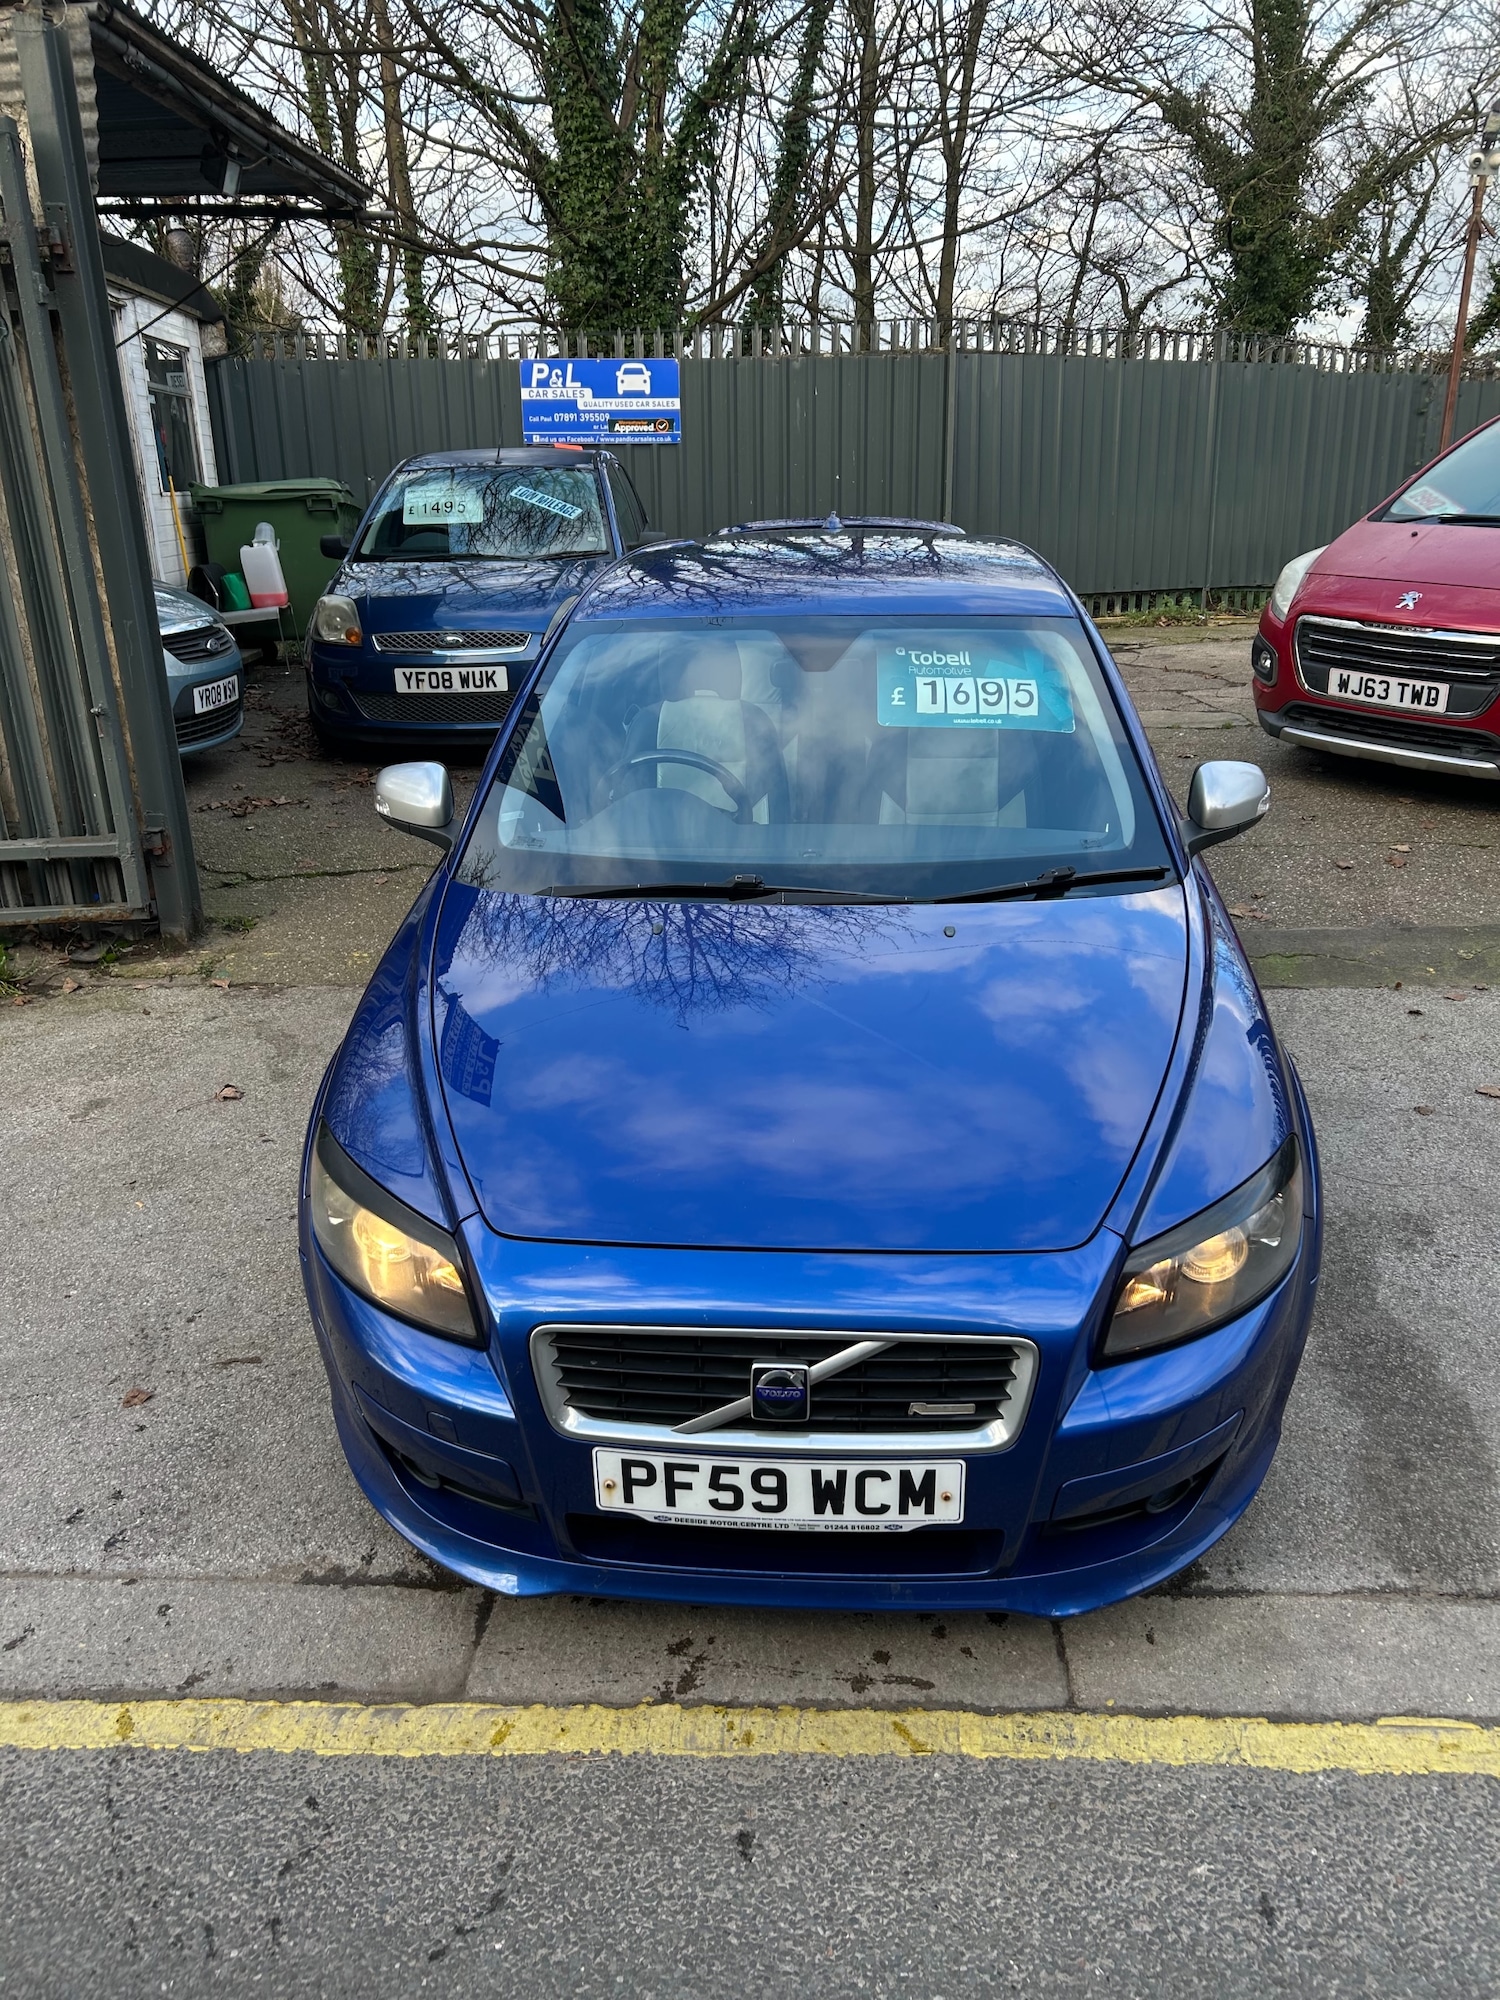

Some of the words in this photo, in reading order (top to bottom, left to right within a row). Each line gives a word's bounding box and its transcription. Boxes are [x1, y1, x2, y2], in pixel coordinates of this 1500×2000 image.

[531, 362, 582, 388] P&L
[528, 389, 549, 398] CAR
[552, 389, 586, 398] SALES
[583, 400, 613, 408] QUALITY
[615, 400, 634, 408] USED
[635, 400, 651, 408] CAR
[652, 400, 676, 408] SALES
[554, 413, 578, 422] 07891
[579, 413, 610, 422] 395509
[408, 506, 415, 515] £
[422, 501, 467, 514] 1495
[515, 487, 539, 505] LOW
[535, 495, 578, 518] MILEAGE
[908, 650, 971, 666] Tobell
[908, 665, 972, 676] Automotive
[402, 671, 453, 690] YF08
[458, 670, 498, 689] WUK
[198, 684, 222, 709] YR08
[890, 686, 906, 706] £
[922, 680, 1035, 708] 1695
[1337, 673, 1391, 701] WJ63
[1397, 682, 1440, 707] TWD
[758, 1388, 801, 1399] VOLVO
[620, 1458, 789, 1514] PF59
[810, 1468, 937, 1516] WCM
[674, 1517, 708, 1525] DEESIDE
[710, 1519, 739, 1527] MOTOR
[740, 1520, 773, 1529] CENTRE
